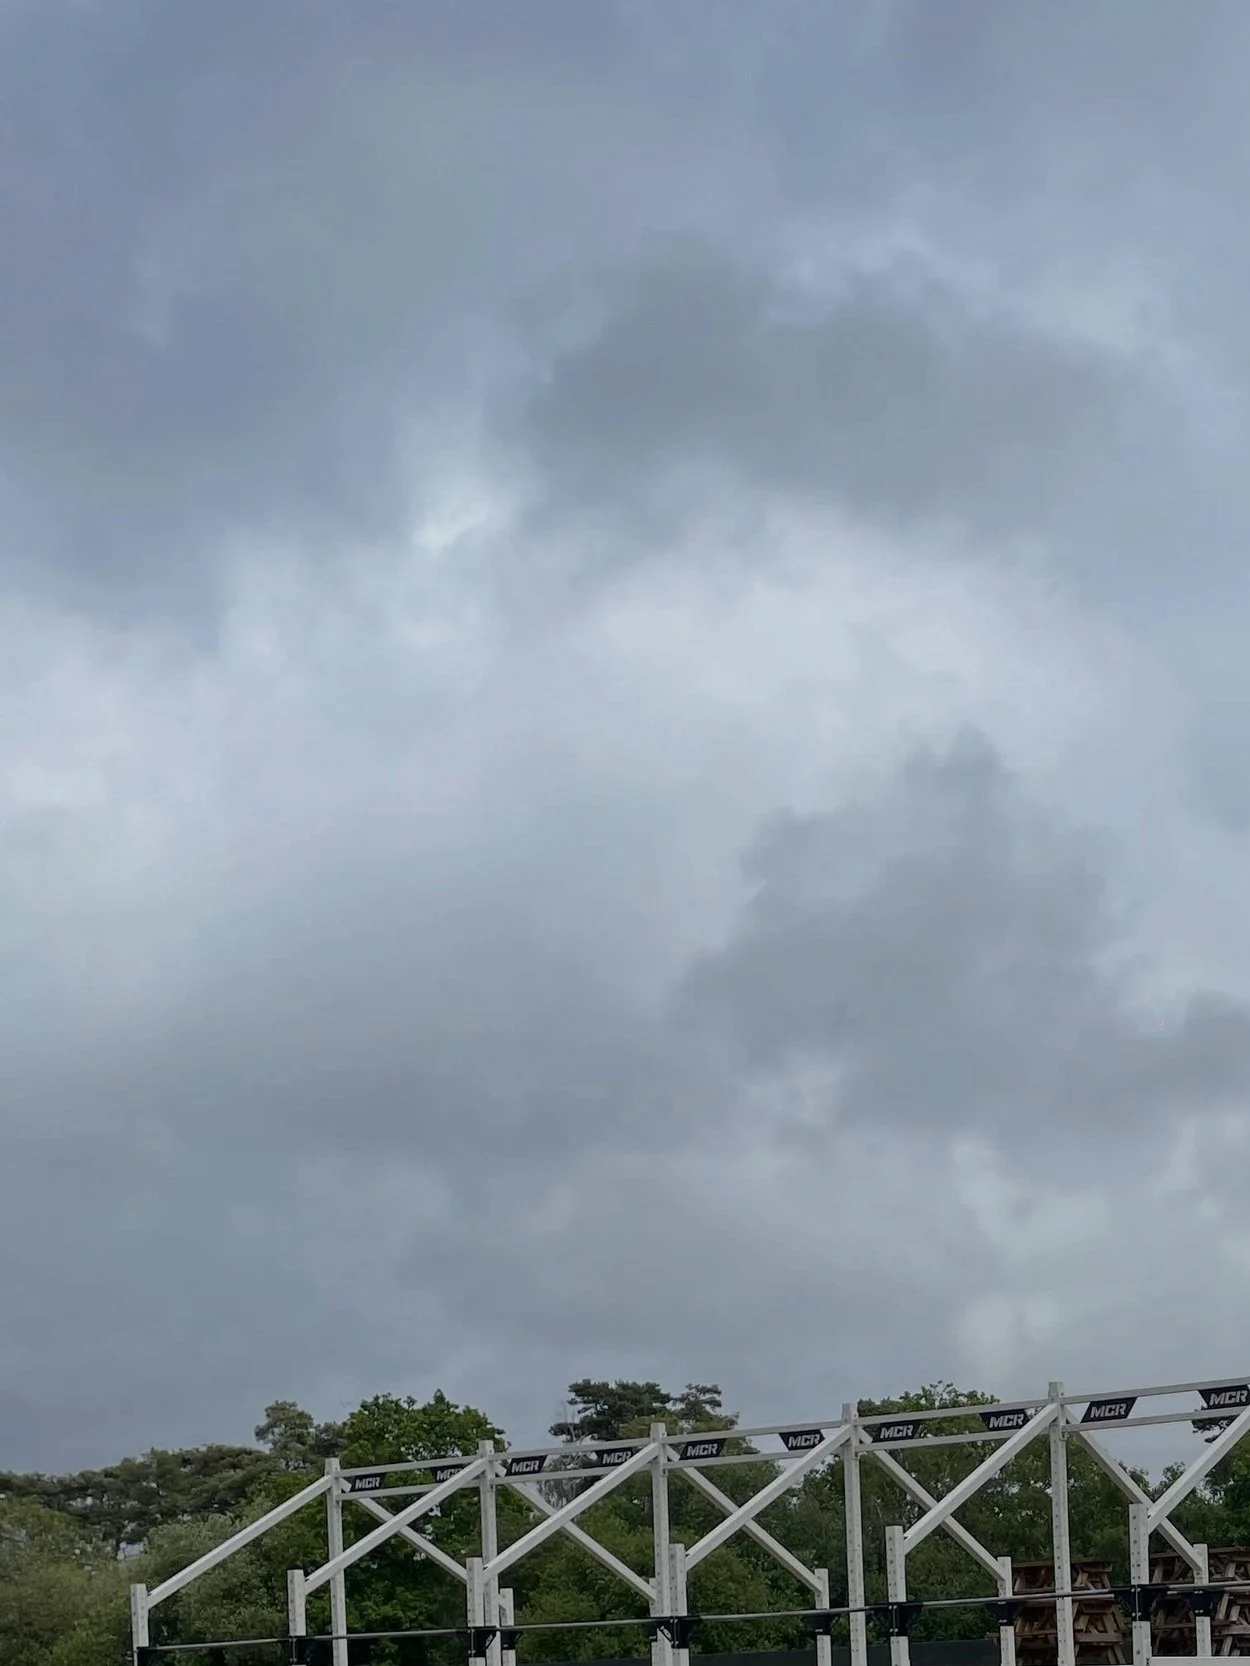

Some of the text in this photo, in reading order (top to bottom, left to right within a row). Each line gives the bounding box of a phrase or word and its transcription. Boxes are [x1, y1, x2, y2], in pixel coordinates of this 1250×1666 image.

[1209, 1389, 1249, 1406] MCR
[1089, 1402, 1127, 1418] MCR
[989, 1413, 1025, 1428] MCR
[880, 1424, 914, 1439] MCR
[788, 1432, 821, 1447] MCR
[602, 1450, 631, 1464] MCR
[686, 1443, 718, 1456] MCR
[511, 1459, 540, 1473] MCR
[355, 1477, 381, 1490] MCR
